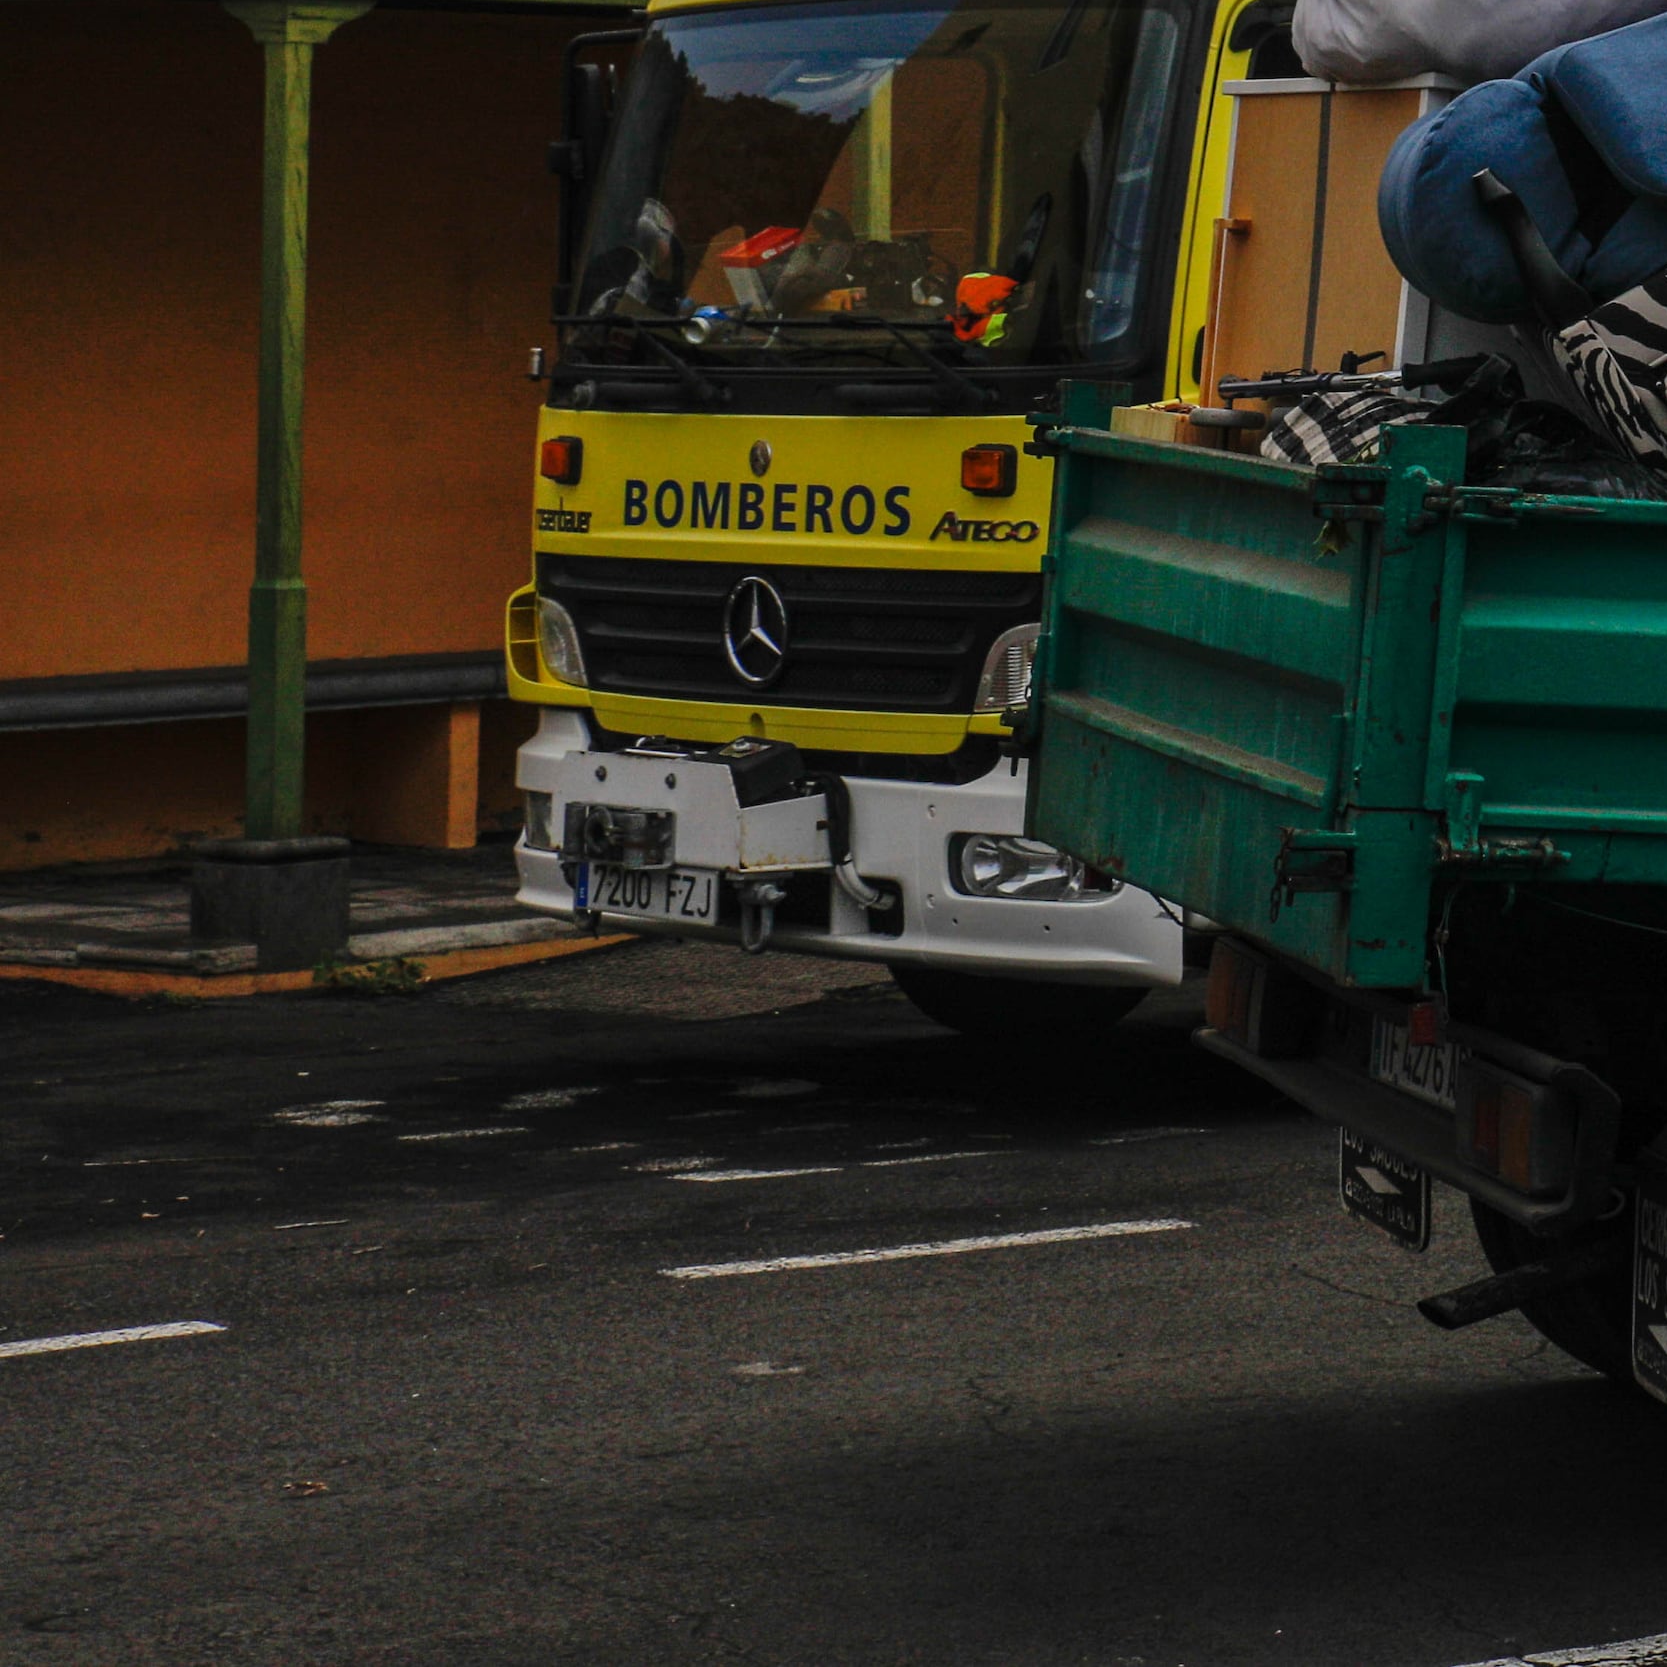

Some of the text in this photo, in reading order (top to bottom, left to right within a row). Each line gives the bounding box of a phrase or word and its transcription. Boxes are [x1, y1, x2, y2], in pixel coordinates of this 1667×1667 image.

[623, 478, 912, 537] BOMBEROS
[594, 865, 712, 918] 7200 FZJ
[1637, 1252, 1660, 1311] LOS
